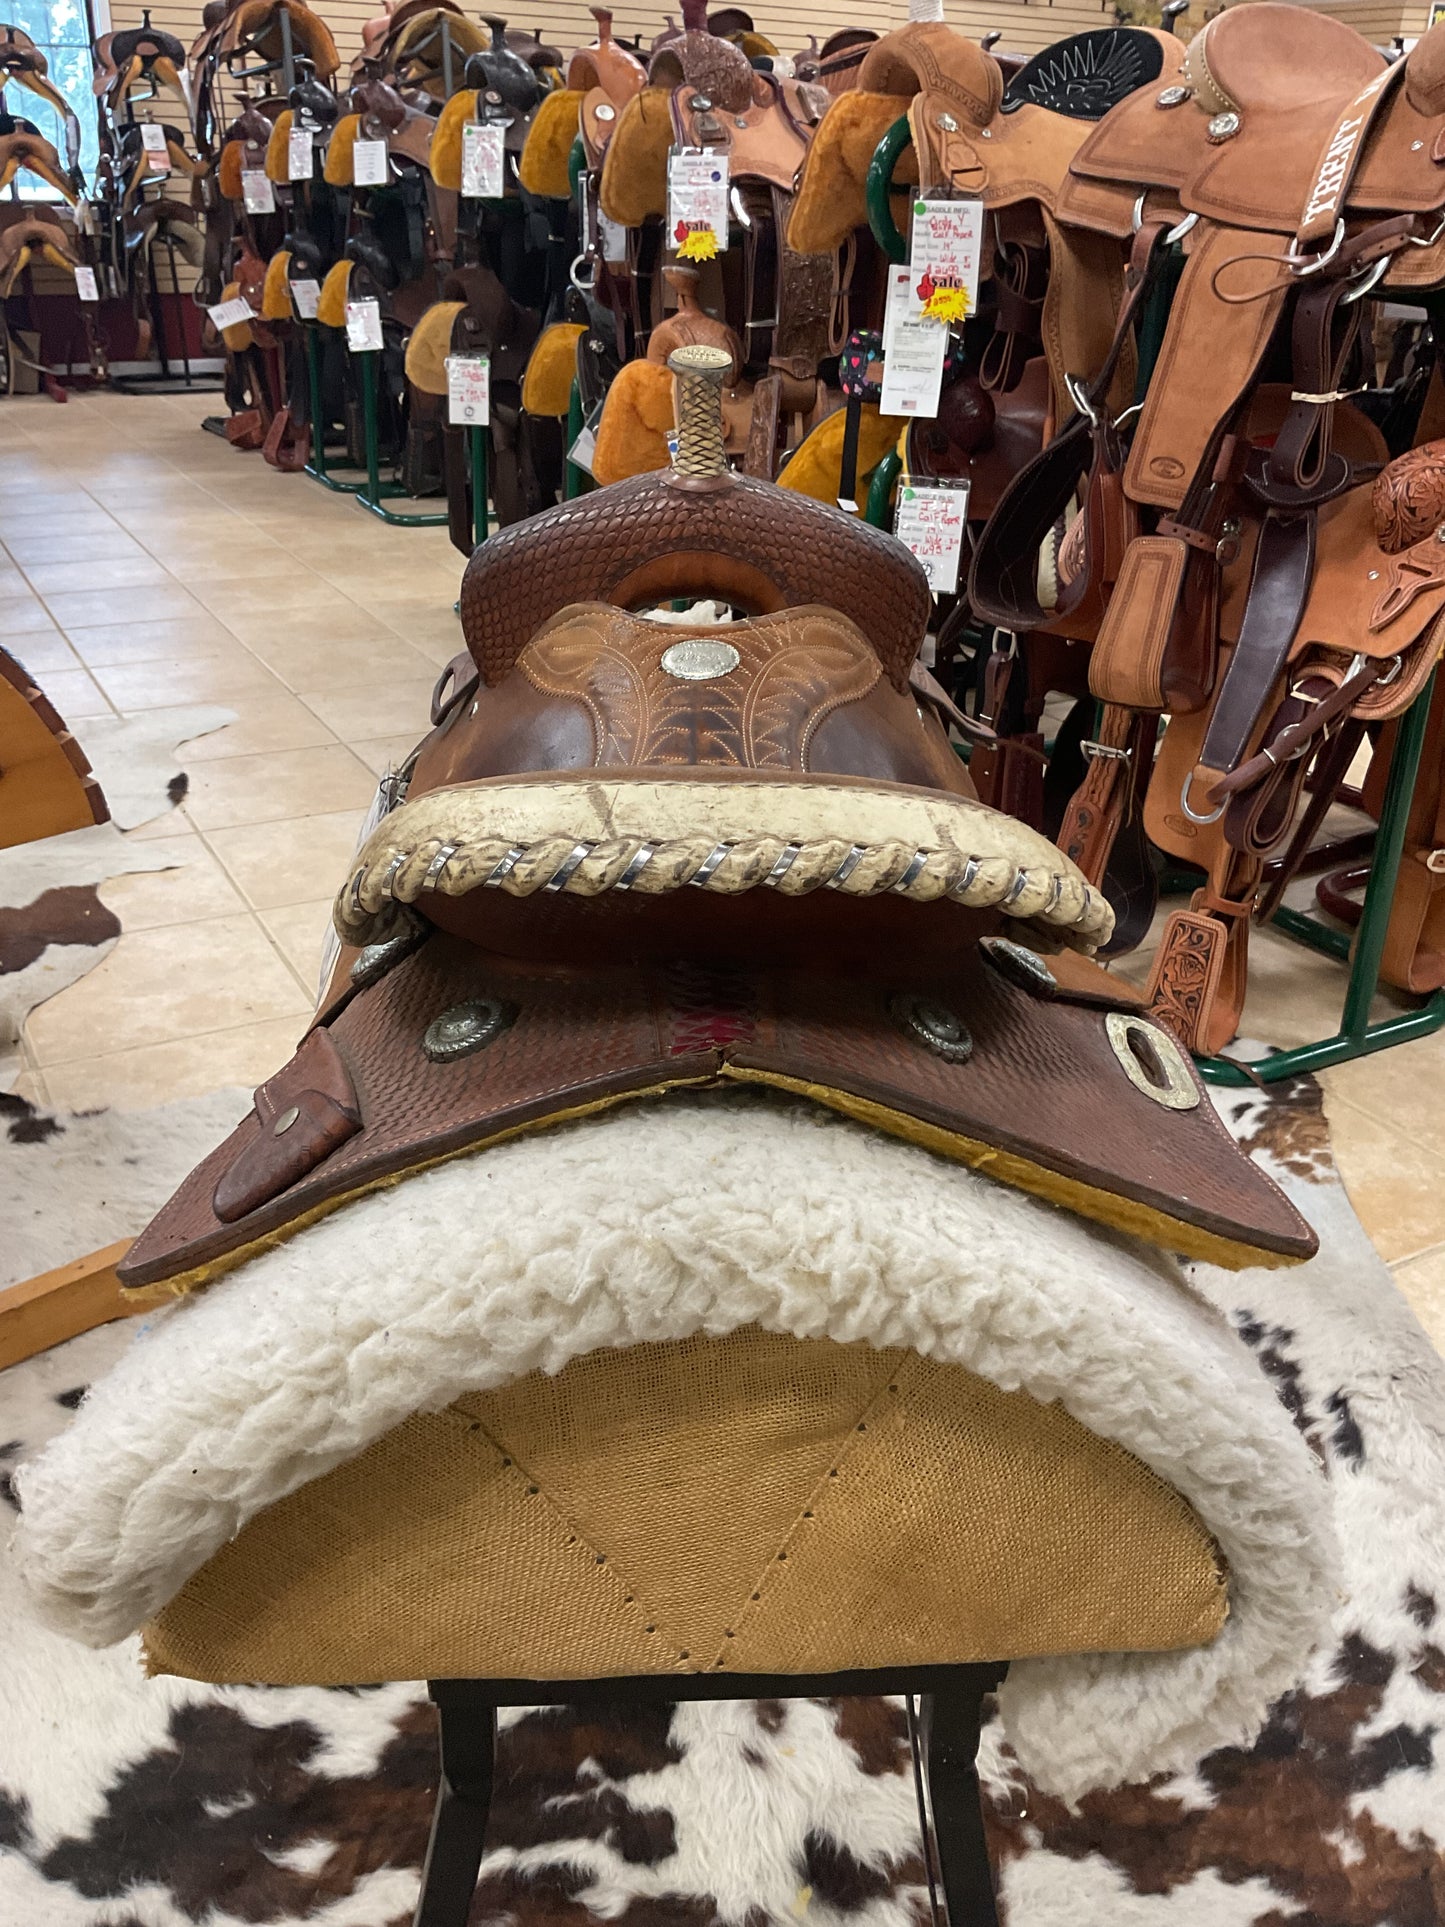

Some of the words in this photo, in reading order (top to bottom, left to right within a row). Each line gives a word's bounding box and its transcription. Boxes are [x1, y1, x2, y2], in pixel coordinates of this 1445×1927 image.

[1303, 114, 1364, 227] TRENT
[685, 220, 712, 231] sale
[931, 275, 964, 288] sale
